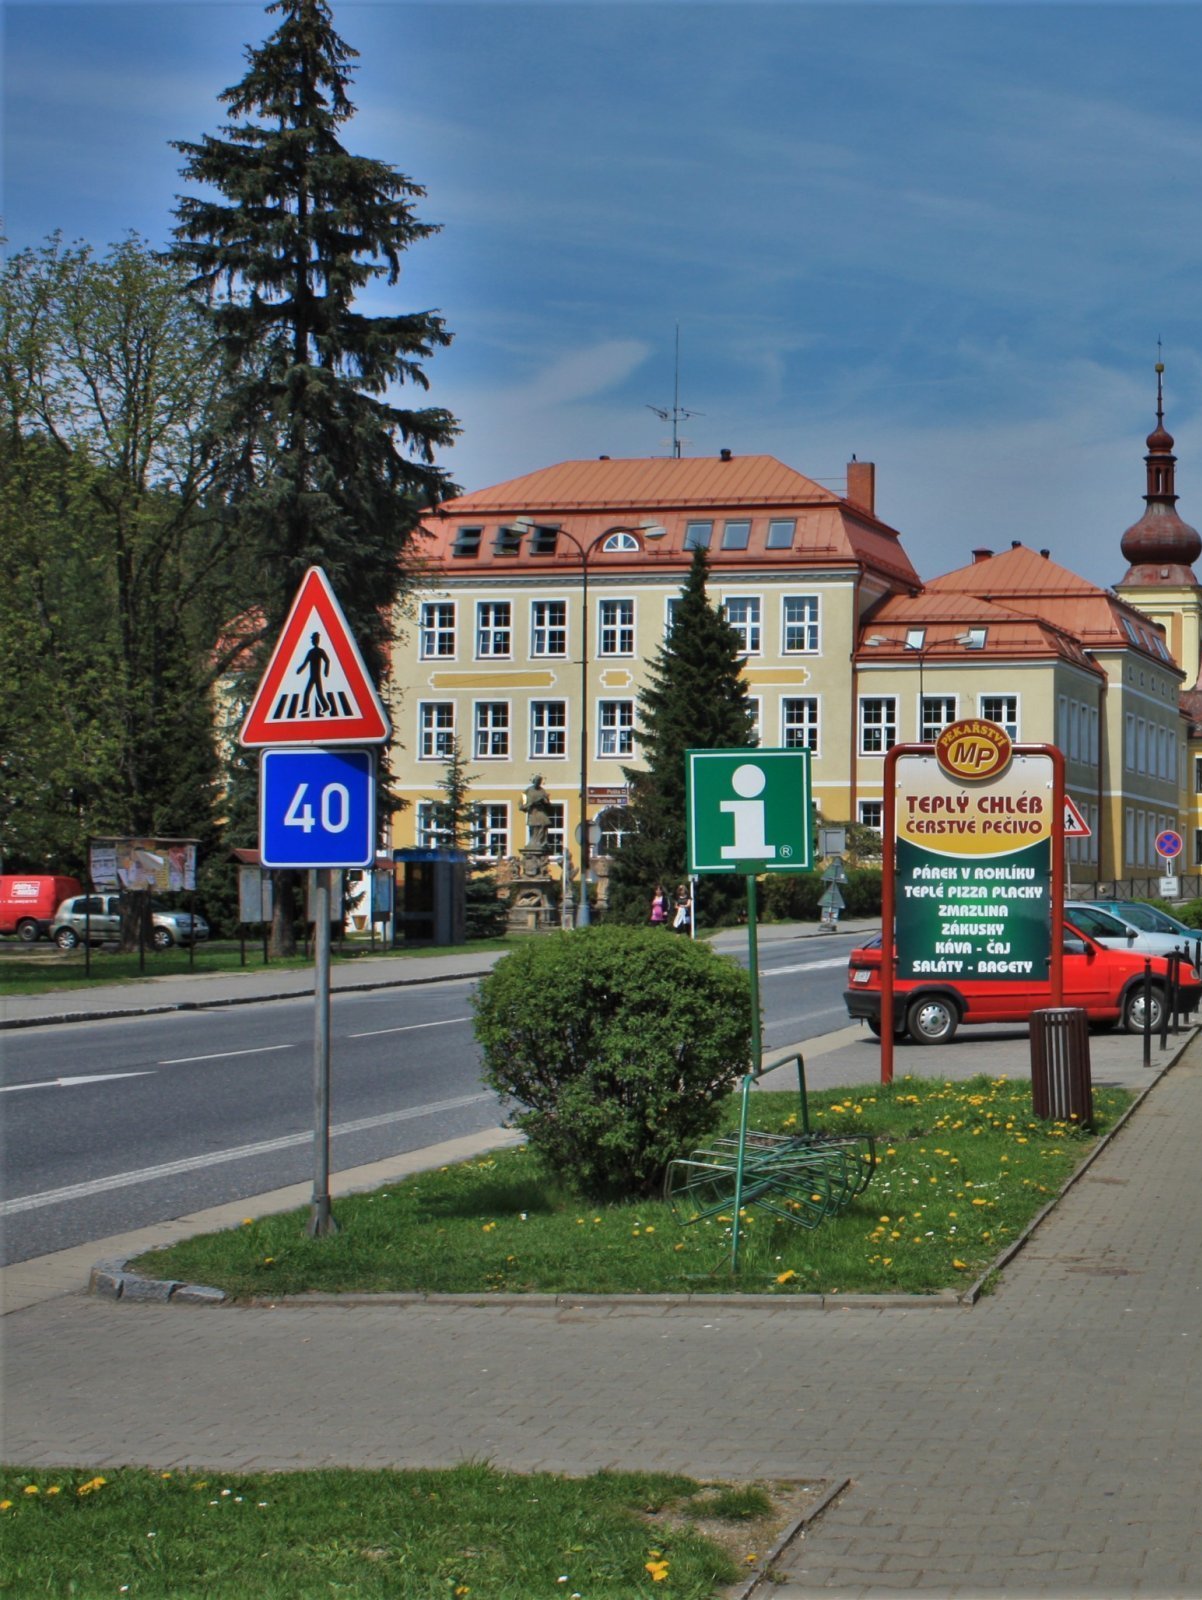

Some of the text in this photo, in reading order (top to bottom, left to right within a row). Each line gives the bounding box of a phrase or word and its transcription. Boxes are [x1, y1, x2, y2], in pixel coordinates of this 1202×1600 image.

[940, 720, 1008, 747] PEKAŘSTVÍ
[953, 742, 995, 769] MP
[284, 782, 350, 834] 40
[906, 791, 1043, 814] TEPLÝ CHLÉB
[906, 816, 1043, 834] ČERSTVÉ PEČIVO
[912, 864, 1035, 880] PÁREK V ROHLÍKU
[904, 883, 1043, 898] TEPLÉ PIZZA PLACKY
[938, 905, 1008, 917] ZMRZLINA
[941, 920, 1004, 935] ZÁKUSKY
[935, 939, 972, 954] KÁVA
[986, 939, 1011, 954] ČAJ
[912, 957, 963, 973] SALÁTY
[977, 961, 1033, 973] BAGETY
